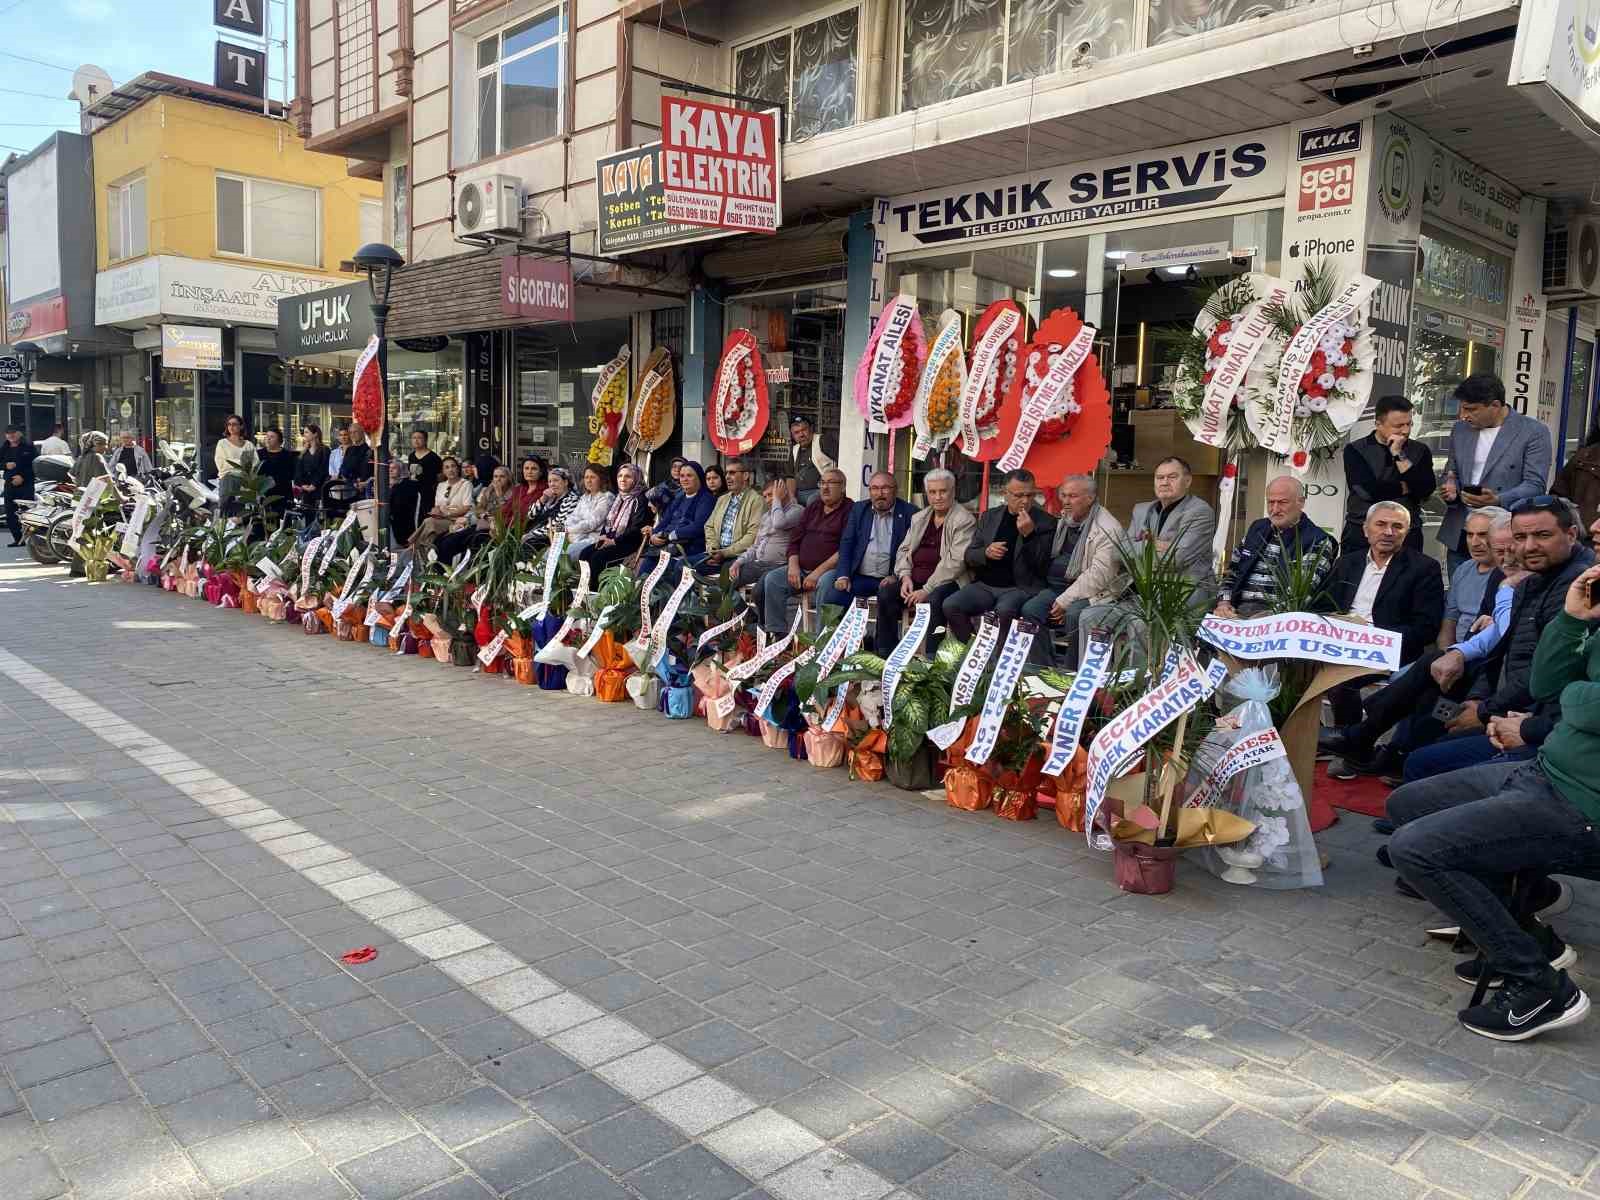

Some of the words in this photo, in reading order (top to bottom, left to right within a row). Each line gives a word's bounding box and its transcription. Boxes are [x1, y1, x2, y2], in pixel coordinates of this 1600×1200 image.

[670, 103, 766, 158] KAYA
[1303, 129, 1357, 152] K.V.K.
[602, 154, 653, 197] KAYA
[667, 150, 772, 199] ELEKTRİK
[893, 180, 1053, 232] TEKNİK
[1068, 142, 1267, 204] SERVİS
[1301, 164, 1354, 193] gen
[701, 198, 718, 207] KAYA
[734, 202, 759, 212] MEHMET
[759, 205, 774, 214] KAYA
[1316, 182, 1354, 208] pa
[727, 212, 742, 224] 0505
[766, 217, 774, 227] 25
[964, 218, 1029, 238] TELEFON
[1032, 209, 1088, 228] TAMİRİ
[1092, 198, 1160, 219] YAPILIR
[1304, 239, 1355, 256] iPhone
[170, 280, 259, 307] İNŞAAT
[507, 272, 569, 310] SİGORTACI
[1372, 280, 1410, 326] EKNİK
[298, 295, 351, 331] UFUK
[301, 329, 350, 347] KUYUMCULUK
[1373, 331, 1405, 377] ERVİS
[480, 334, 489, 383] YSE
[870, 352, 893, 424] AYKANAT
[883, 304, 913, 350] AİLESİ
[1002, 444, 1025, 472] ODYO
[1019, 420, 1036, 444] SER
[1051, 331, 1092, 383] CİHAZLARI
[1200, 389, 1224, 443] AVUKAT
[1219, 338, 1252, 389] İSMAİL
[1276, 619, 1395, 648] LOKANTASI
[1299, 639, 1389, 664] USTA
[1097, 656, 1197, 753] ECZANESİ
[1045, 709, 1082, 772] TANER
[1094, 741, 1129, 799] ZEYBEK
